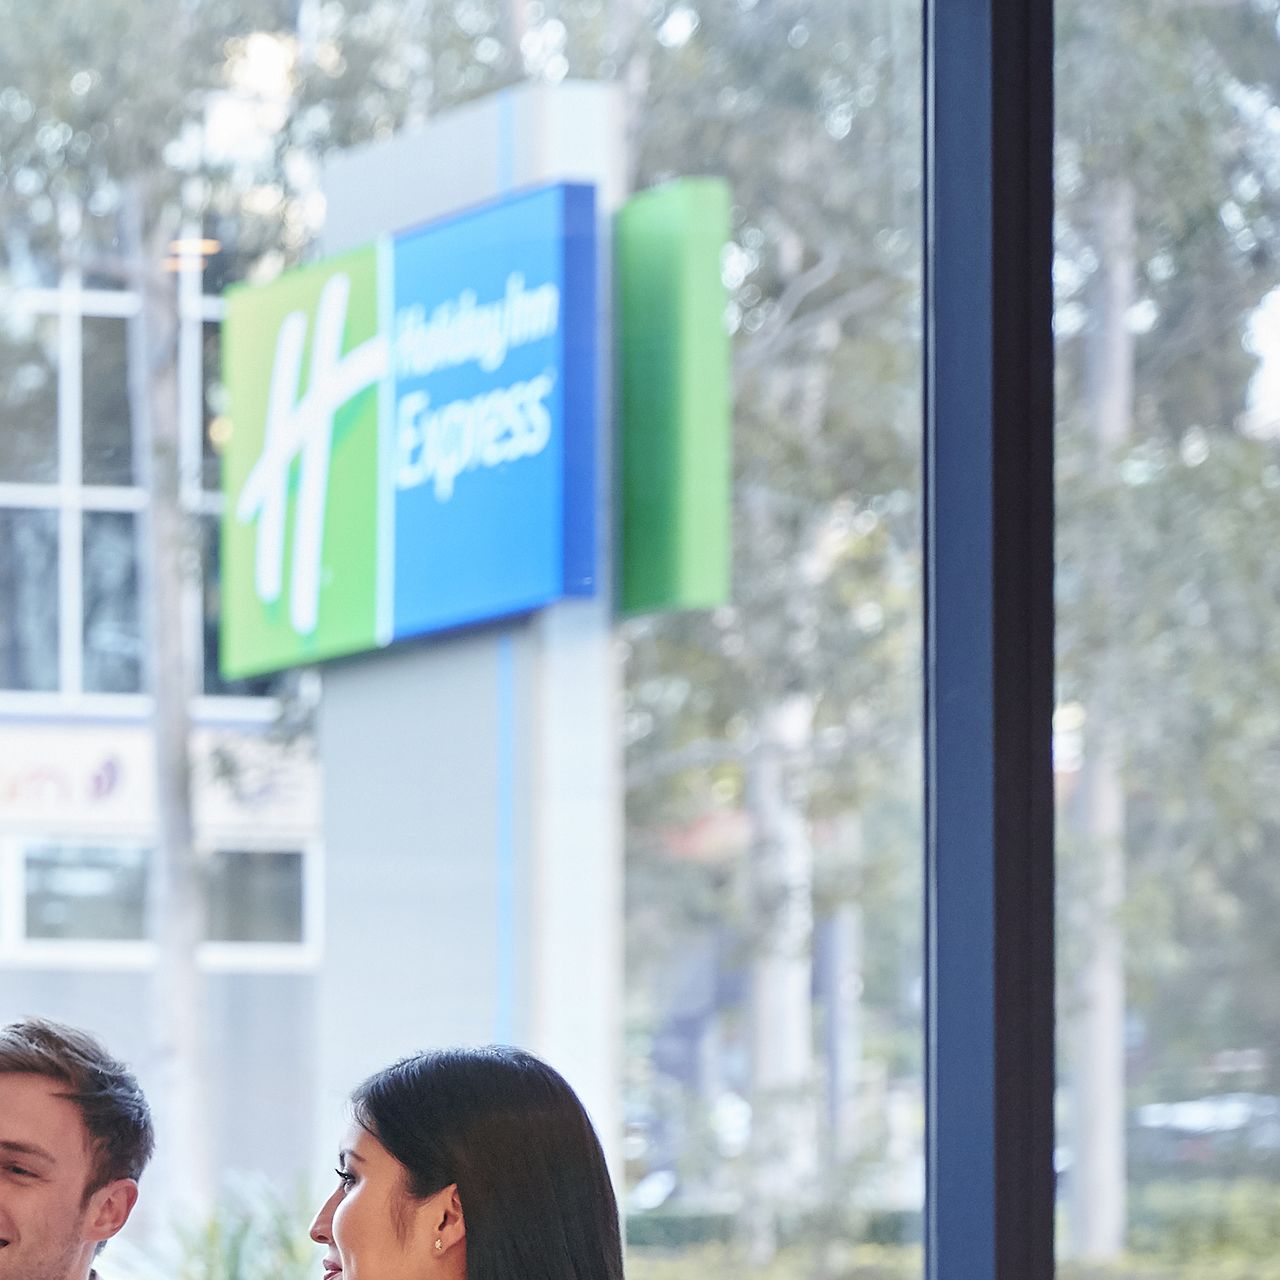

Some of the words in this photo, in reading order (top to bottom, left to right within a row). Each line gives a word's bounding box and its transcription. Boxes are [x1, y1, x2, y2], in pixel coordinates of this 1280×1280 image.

[395, 288, 506, 376] Holiday
[504, 272, 559, 347] Inn
[395, 376, 554, 502] Express
